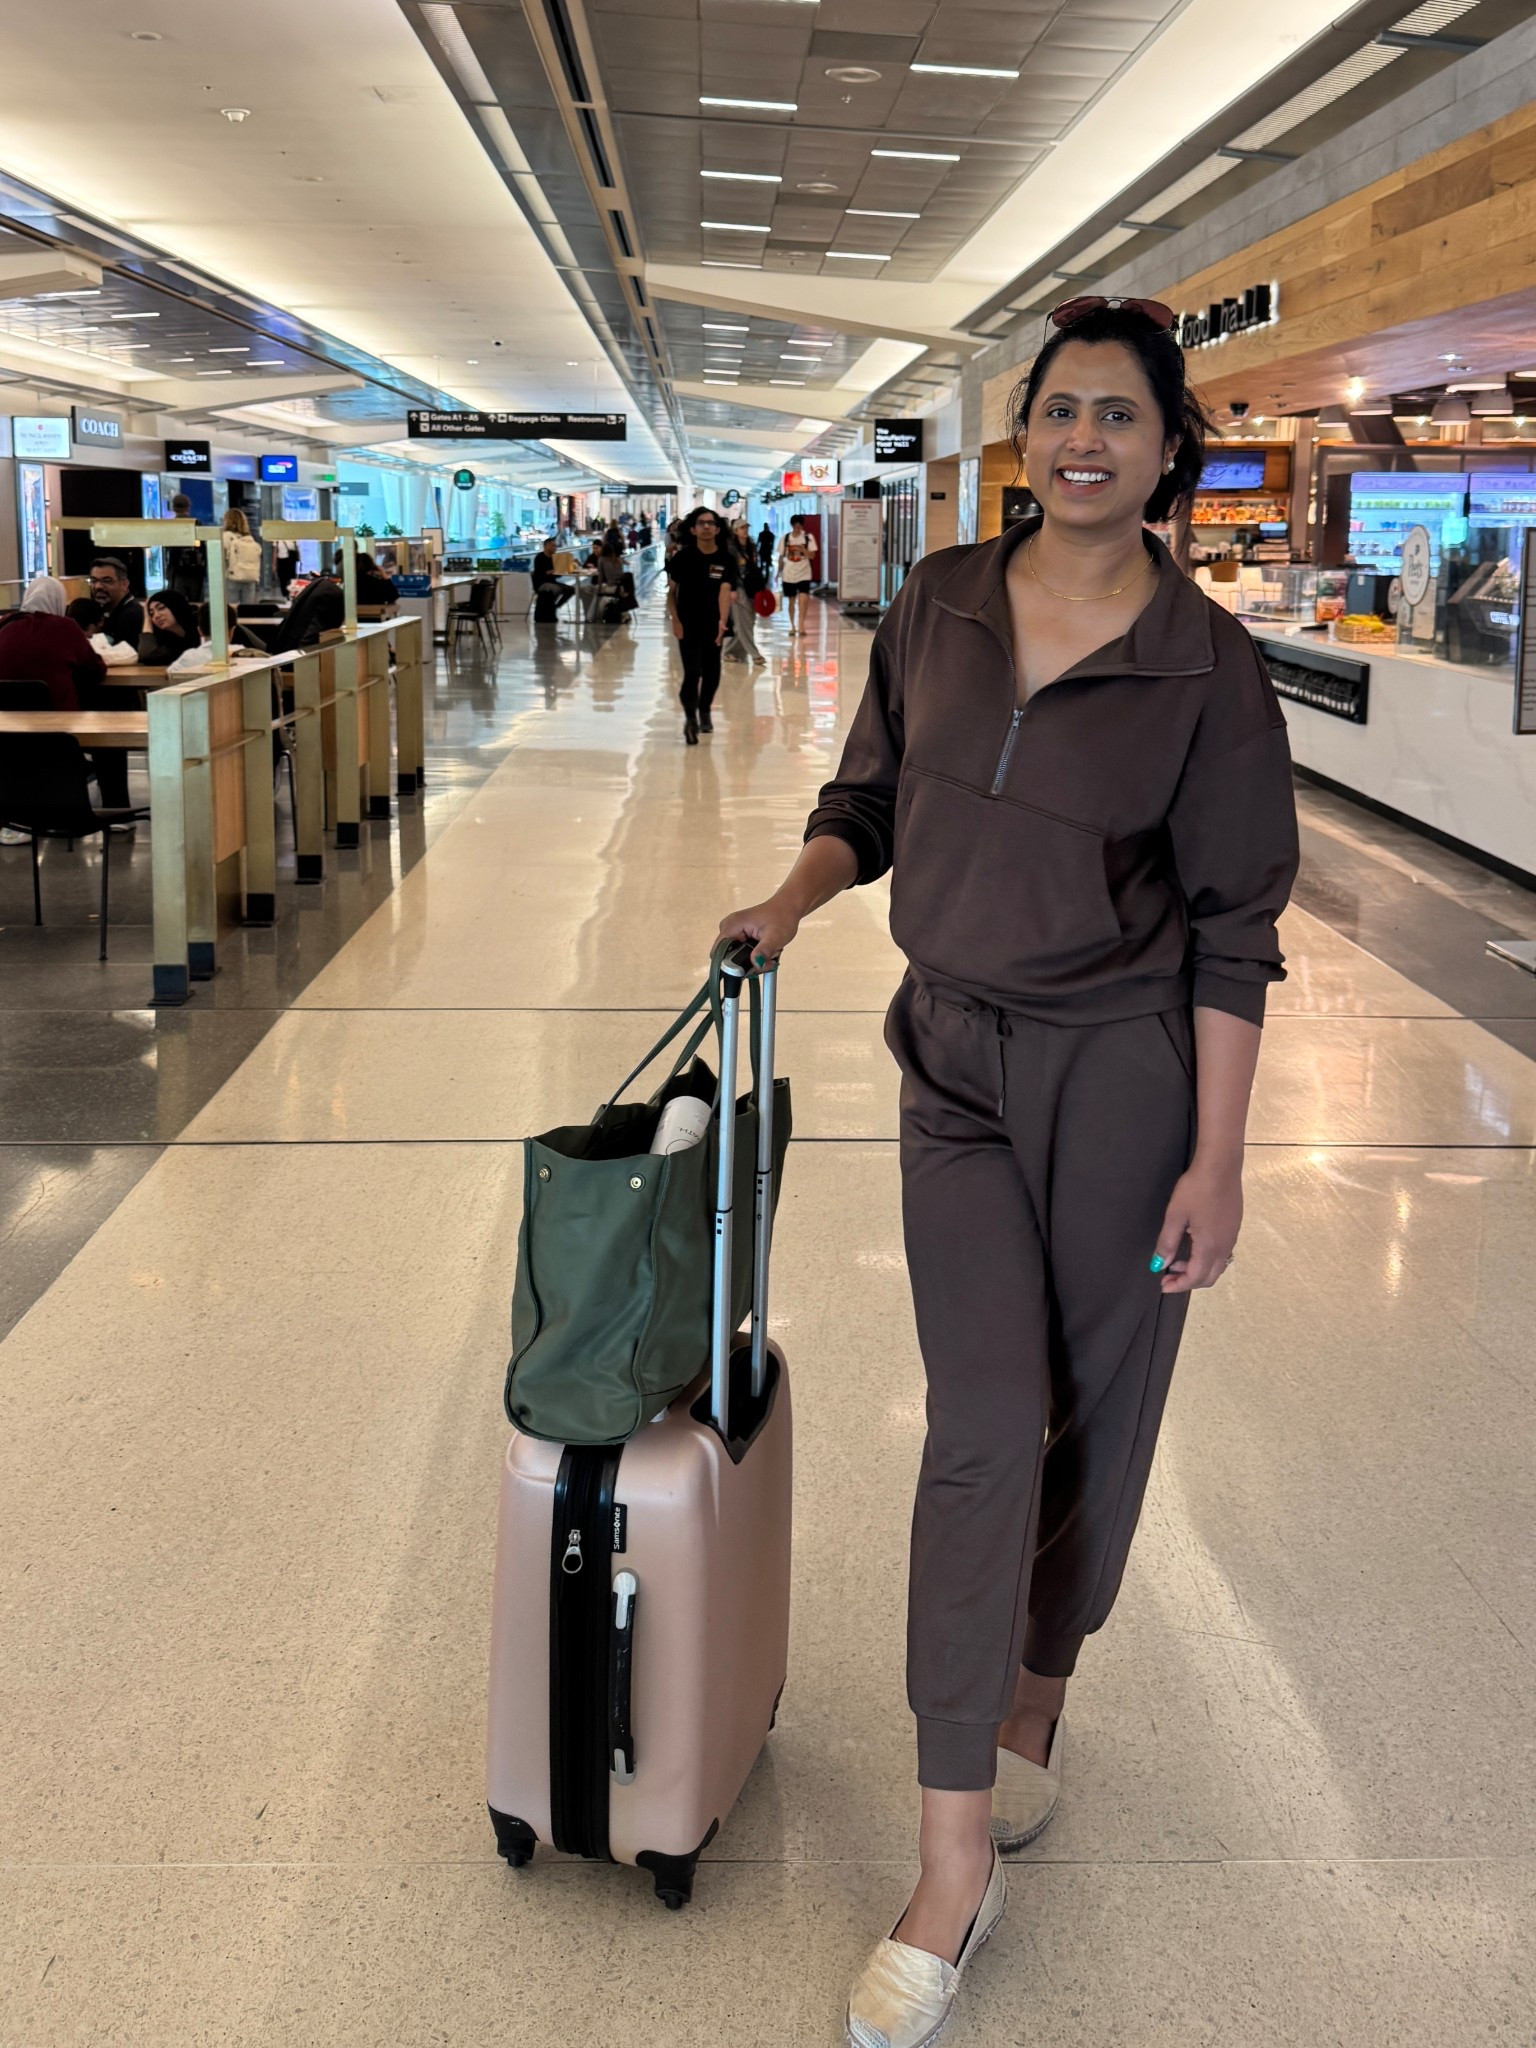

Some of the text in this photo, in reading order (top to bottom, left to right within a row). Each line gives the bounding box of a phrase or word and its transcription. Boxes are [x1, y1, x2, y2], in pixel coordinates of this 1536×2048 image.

[508, 415, 539, 424] Baggage
[567, 415, 606, 423] Restrooms
[80, 418, 119, 437] COACH
[613, 1506, 621, 1550] Samsonite
